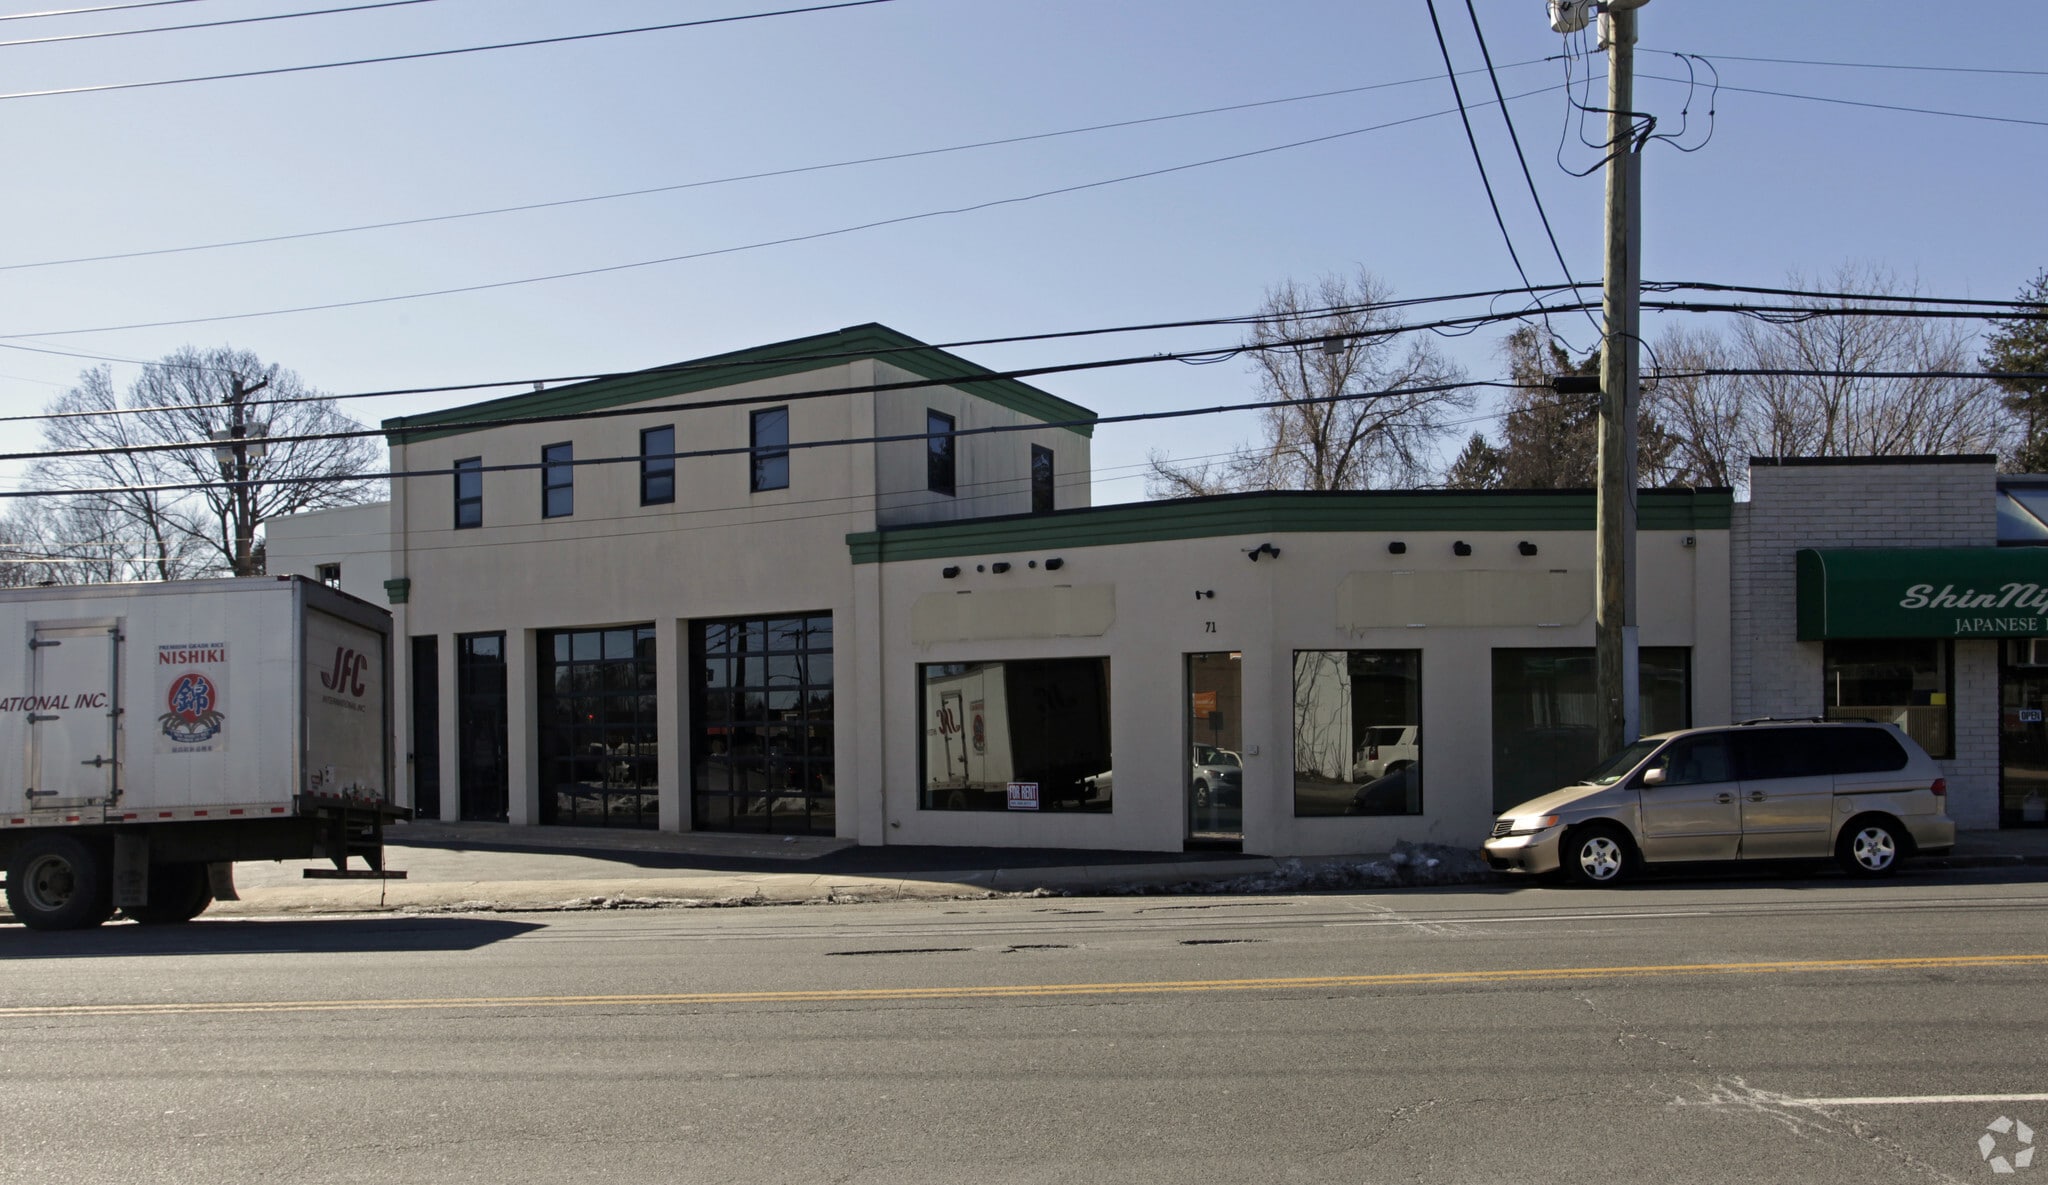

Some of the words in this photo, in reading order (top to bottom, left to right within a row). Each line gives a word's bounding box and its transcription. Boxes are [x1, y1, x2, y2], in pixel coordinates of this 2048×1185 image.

[1205, 621, 1217, 633] 71
[1954, 617, 2038, 634] JAPANESE
[159, 649, 225, 664] NISHIKI
[320, 646, 367, 697] JFC
[0, 694, 70, 712] ATIONAL
[74, 692, 109, 709] INC.
[2021, 711, 2041, 720] OPEN
[1009, 785, 1020, 800] FOR
[1021, 785, 1036, 800] RENT
